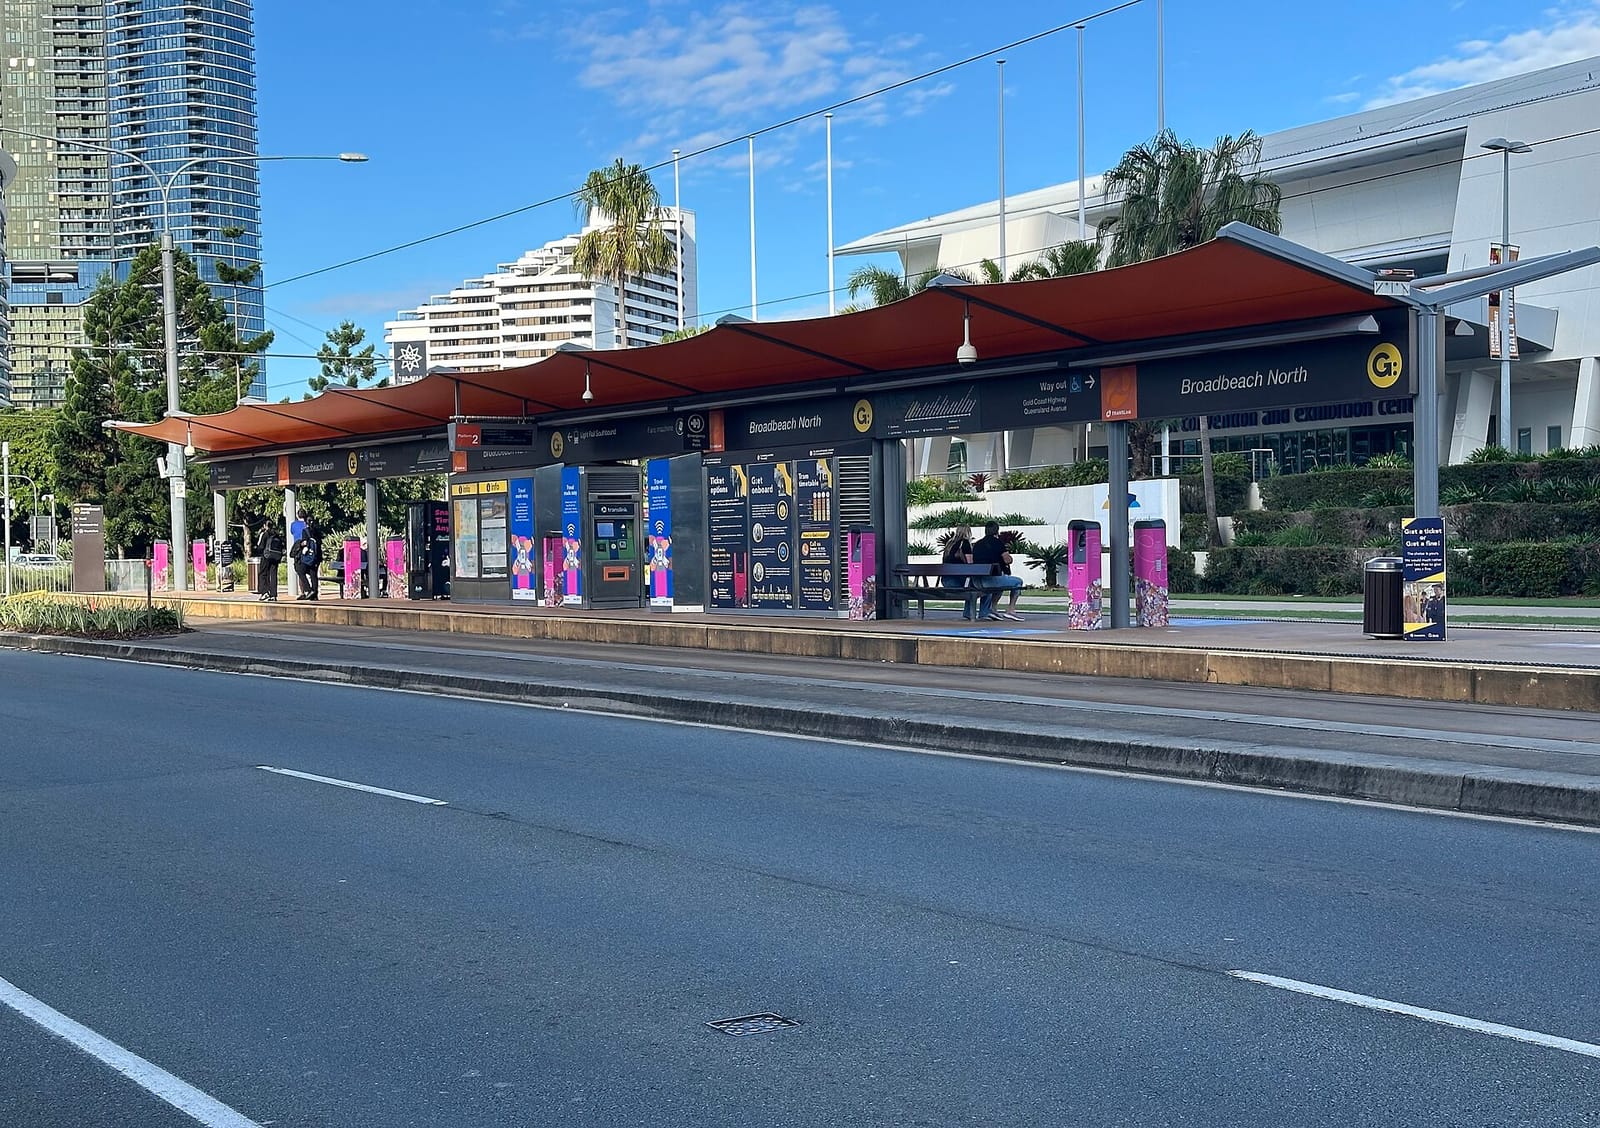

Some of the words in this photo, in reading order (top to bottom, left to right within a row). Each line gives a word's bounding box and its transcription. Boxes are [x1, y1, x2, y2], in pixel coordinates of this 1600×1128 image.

[1181, 370, 1263, 394] Broadbeach
[1266, 366, 1308, 386] North
[1040, 382, 1054, 393] Way
[1055, 380, 1067, 389] out
[749, 417, 797, 434] Broadbeach
[799, 414, 822, 428] North
[472, 434, 479, 444] 2
[300, 462, 322, 473] Broadbeach
[710, 476, 725, 485] Ticket
[710, 486, 728, 495] options
[751, 485, 773, 494] onboard
